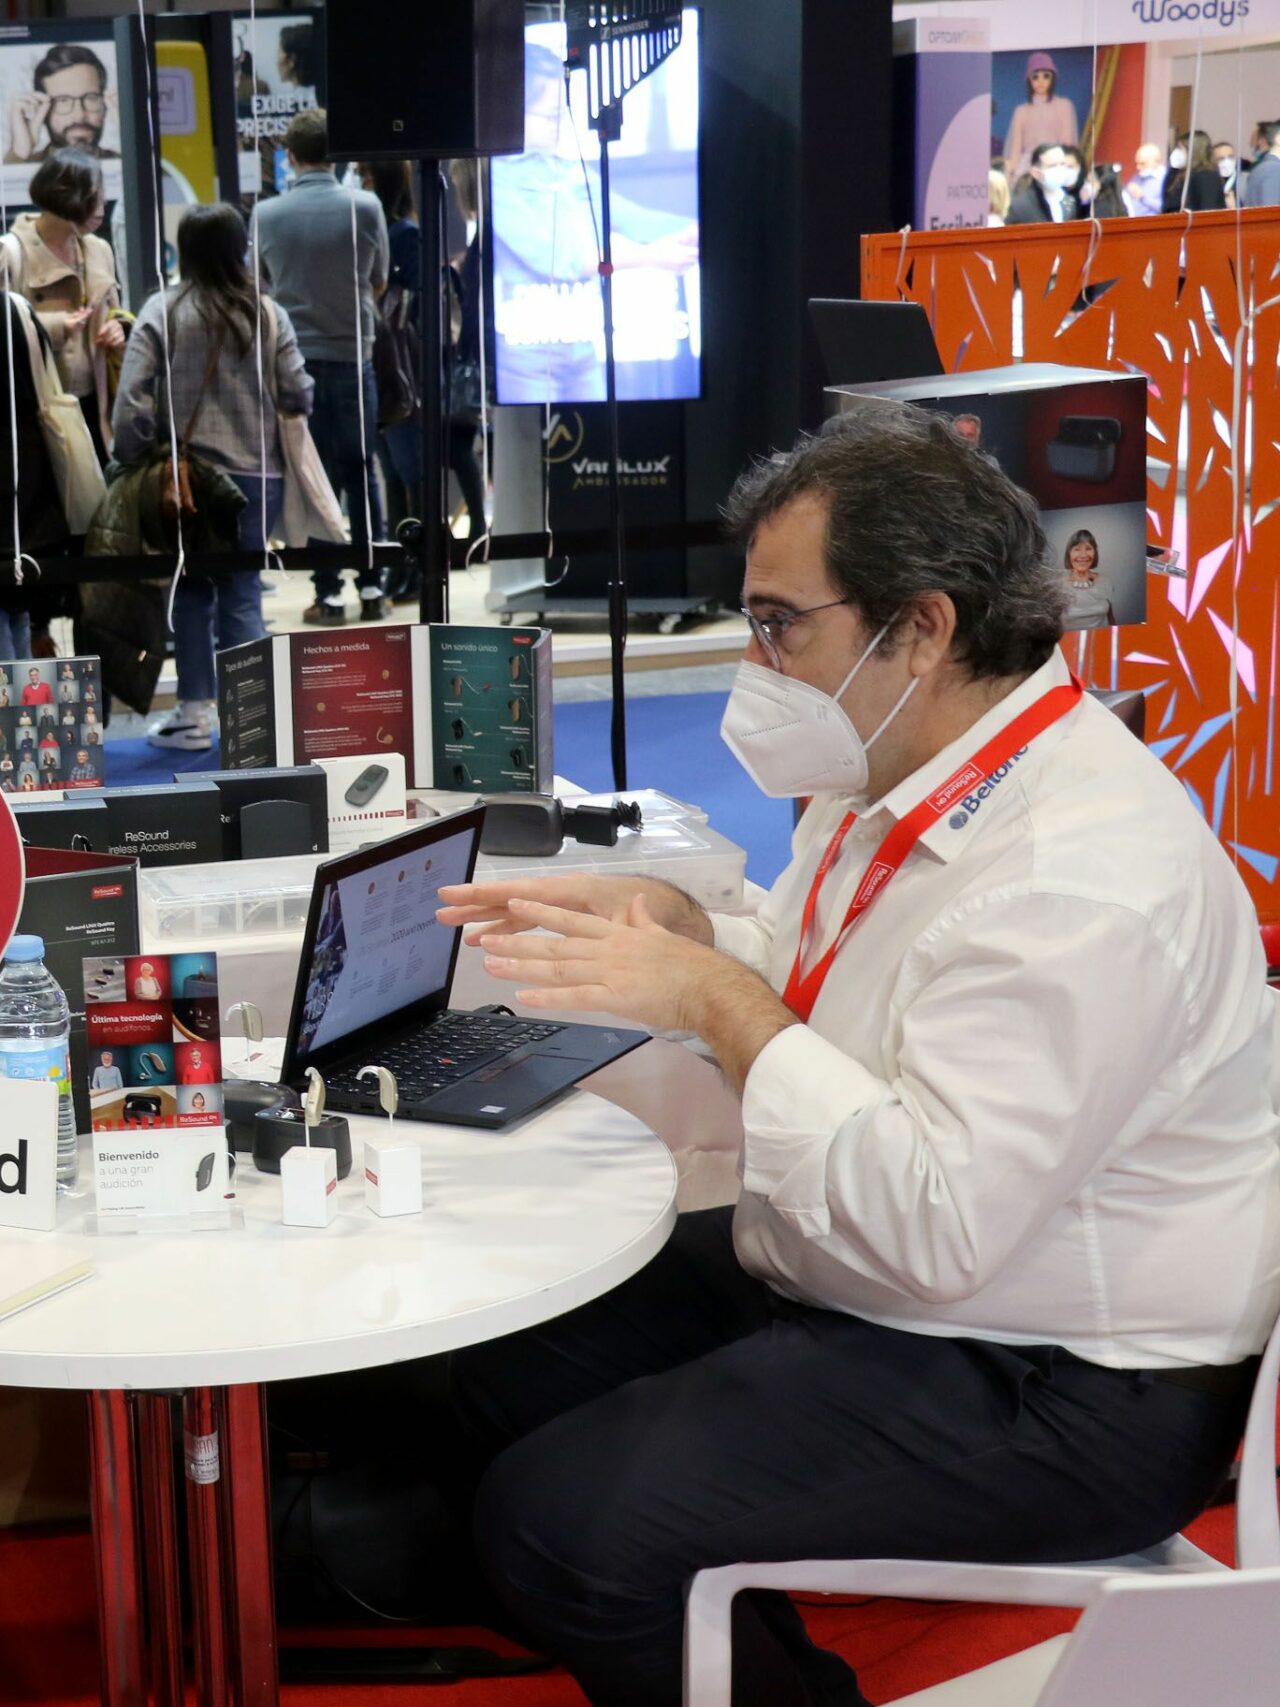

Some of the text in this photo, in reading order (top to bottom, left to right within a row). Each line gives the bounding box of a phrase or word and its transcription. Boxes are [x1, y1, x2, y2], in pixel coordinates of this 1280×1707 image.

[1132, 0, 1250, 27] Woodys
[237, 116, 288, 138] PRECIS
[303, 645, 333, 655] Hechos
[341, 642, 370, 652] medida
[441, 643, 499, 653] Un sonido único
[944, 769, 977, 799] ReSound
[125, 829, 170, 843] ReSound
[108, 840, 198, 855] ireless Accessories
[91, 1014, 120, 1024] Última
[120, 1012, 163, 1025] tecnología
[103, 1026, 113, 1034] en
[179, 1115, 209, 1123] ReSound
[99, 1150, 160, 1162] Bienvenido
[99, 1164, 154, 1178] a una gran
[99, 1178, 144, 1189] audición
